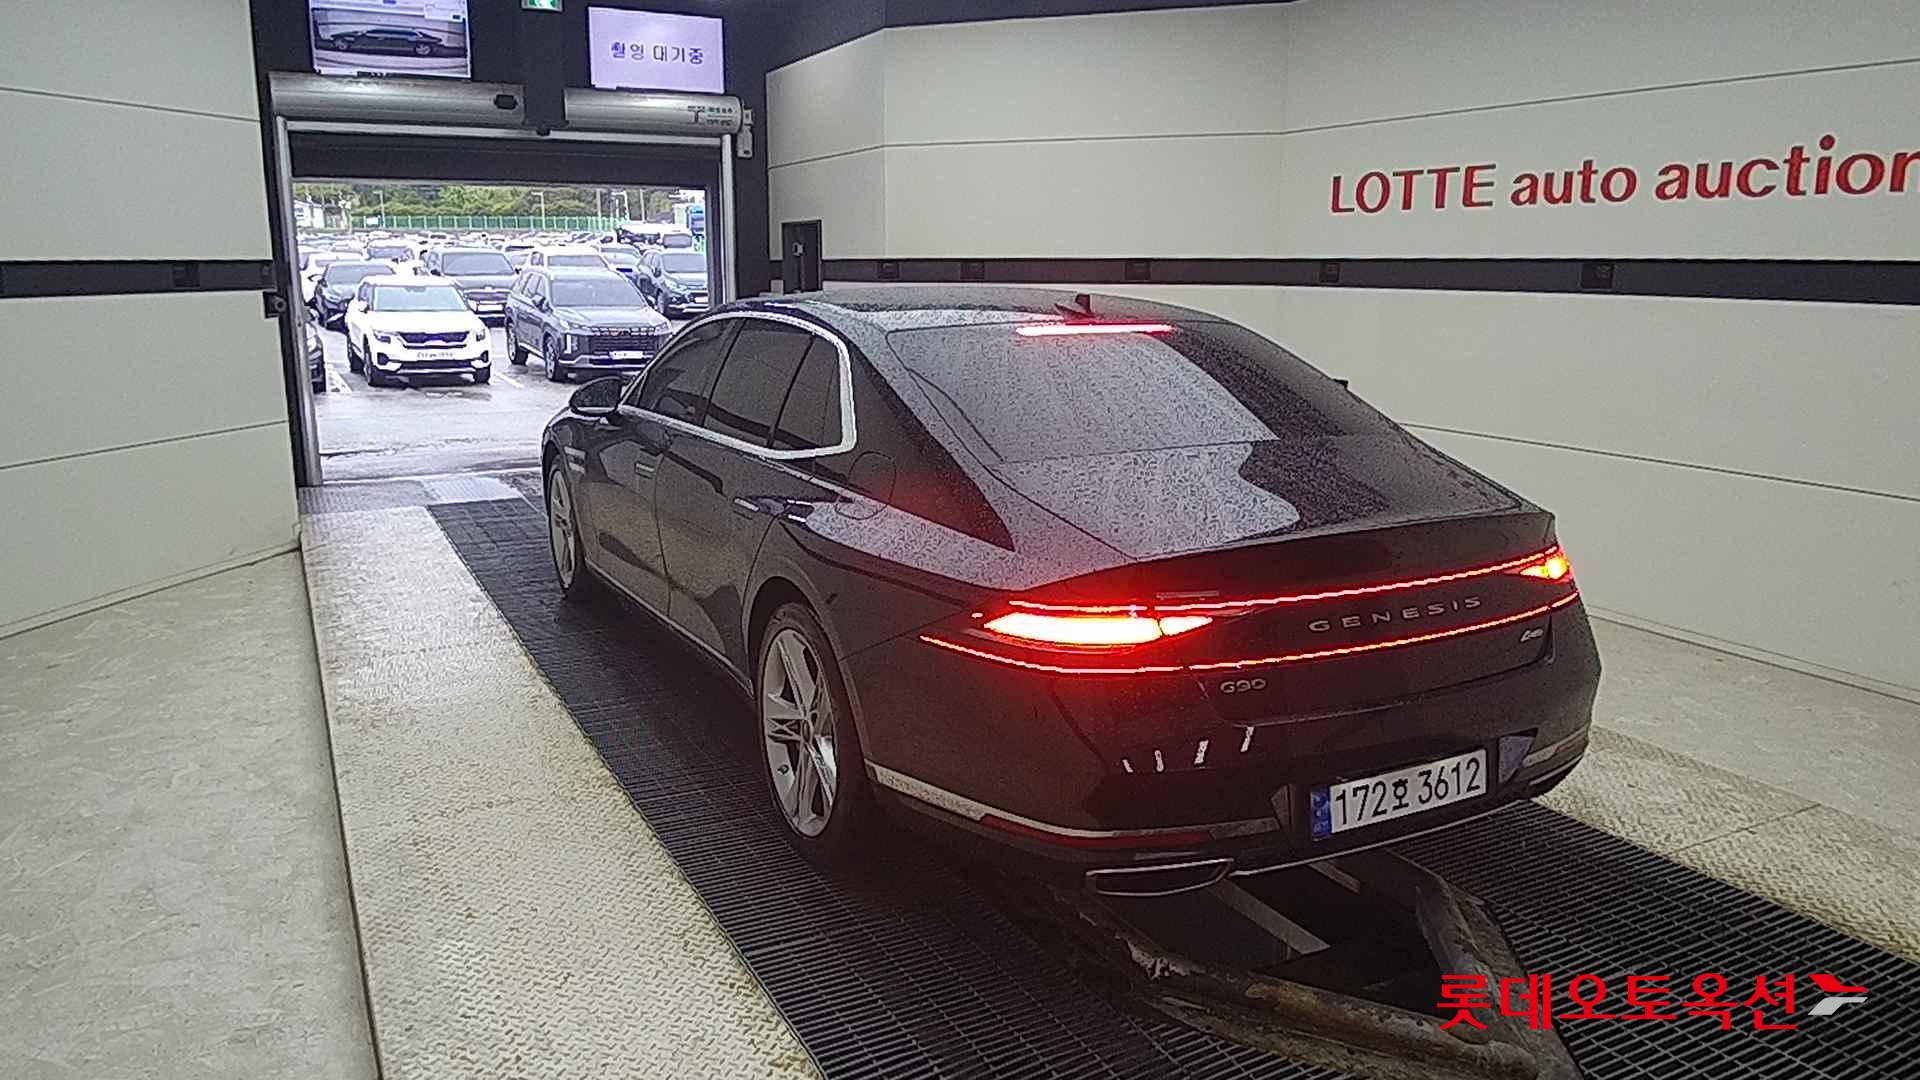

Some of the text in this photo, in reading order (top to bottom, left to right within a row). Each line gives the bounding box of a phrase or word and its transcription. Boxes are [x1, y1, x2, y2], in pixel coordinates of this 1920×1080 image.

[653, 45, 704, 65] 대기중
[1331, 134, 1920, 213] LOTTE auto auction
[1308, 596, 1481, 632] GENESIS
[1220, 678, 1266, 693] G90
[1418, 757, 1480, 804] 3612
